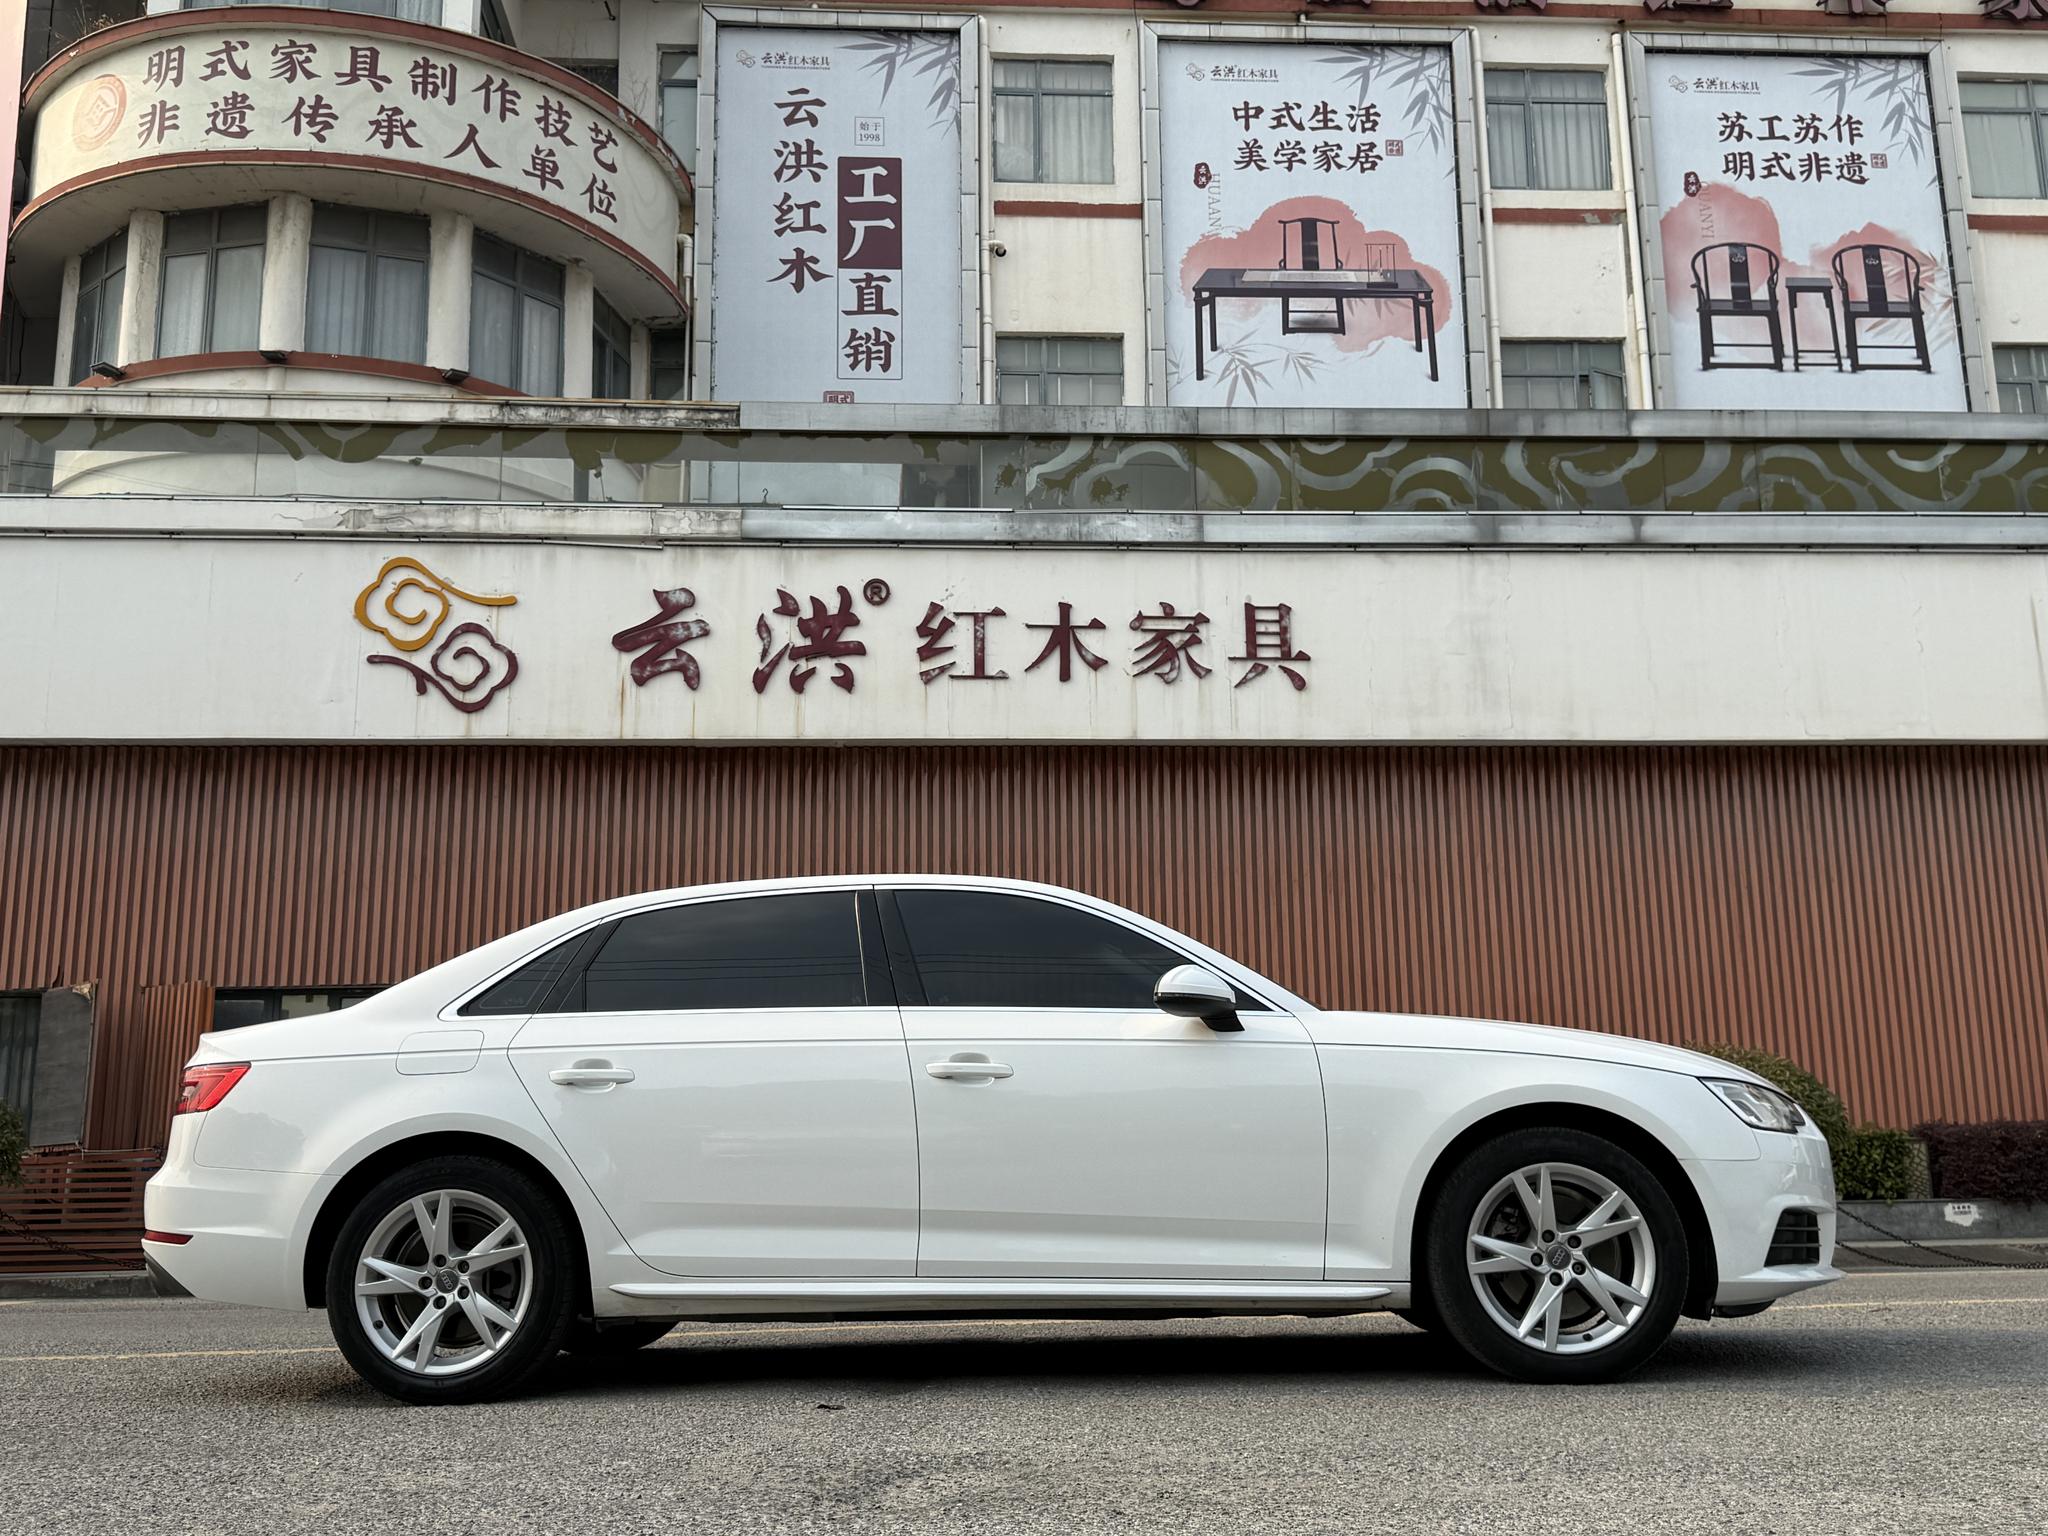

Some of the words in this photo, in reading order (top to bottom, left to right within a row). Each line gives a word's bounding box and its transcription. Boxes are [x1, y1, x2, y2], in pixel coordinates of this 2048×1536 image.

[142, 39, 619, 174] 明式家具制作技艺
[1231, 100, 1382, 134] 中式生活
[859, 133, 881, 142] 1998
[1716, 110, 1864, 146] 苏工苏作
[137, 91, 618, 223] 非遗传承人单位
[1233, 138, 1384, 174] 美学家居
[1721, 151, 1870, 185] 明式非遗
[765, 87, 834, 294] 云洪红木
[841, 165, 899, 374] 工厂直销
